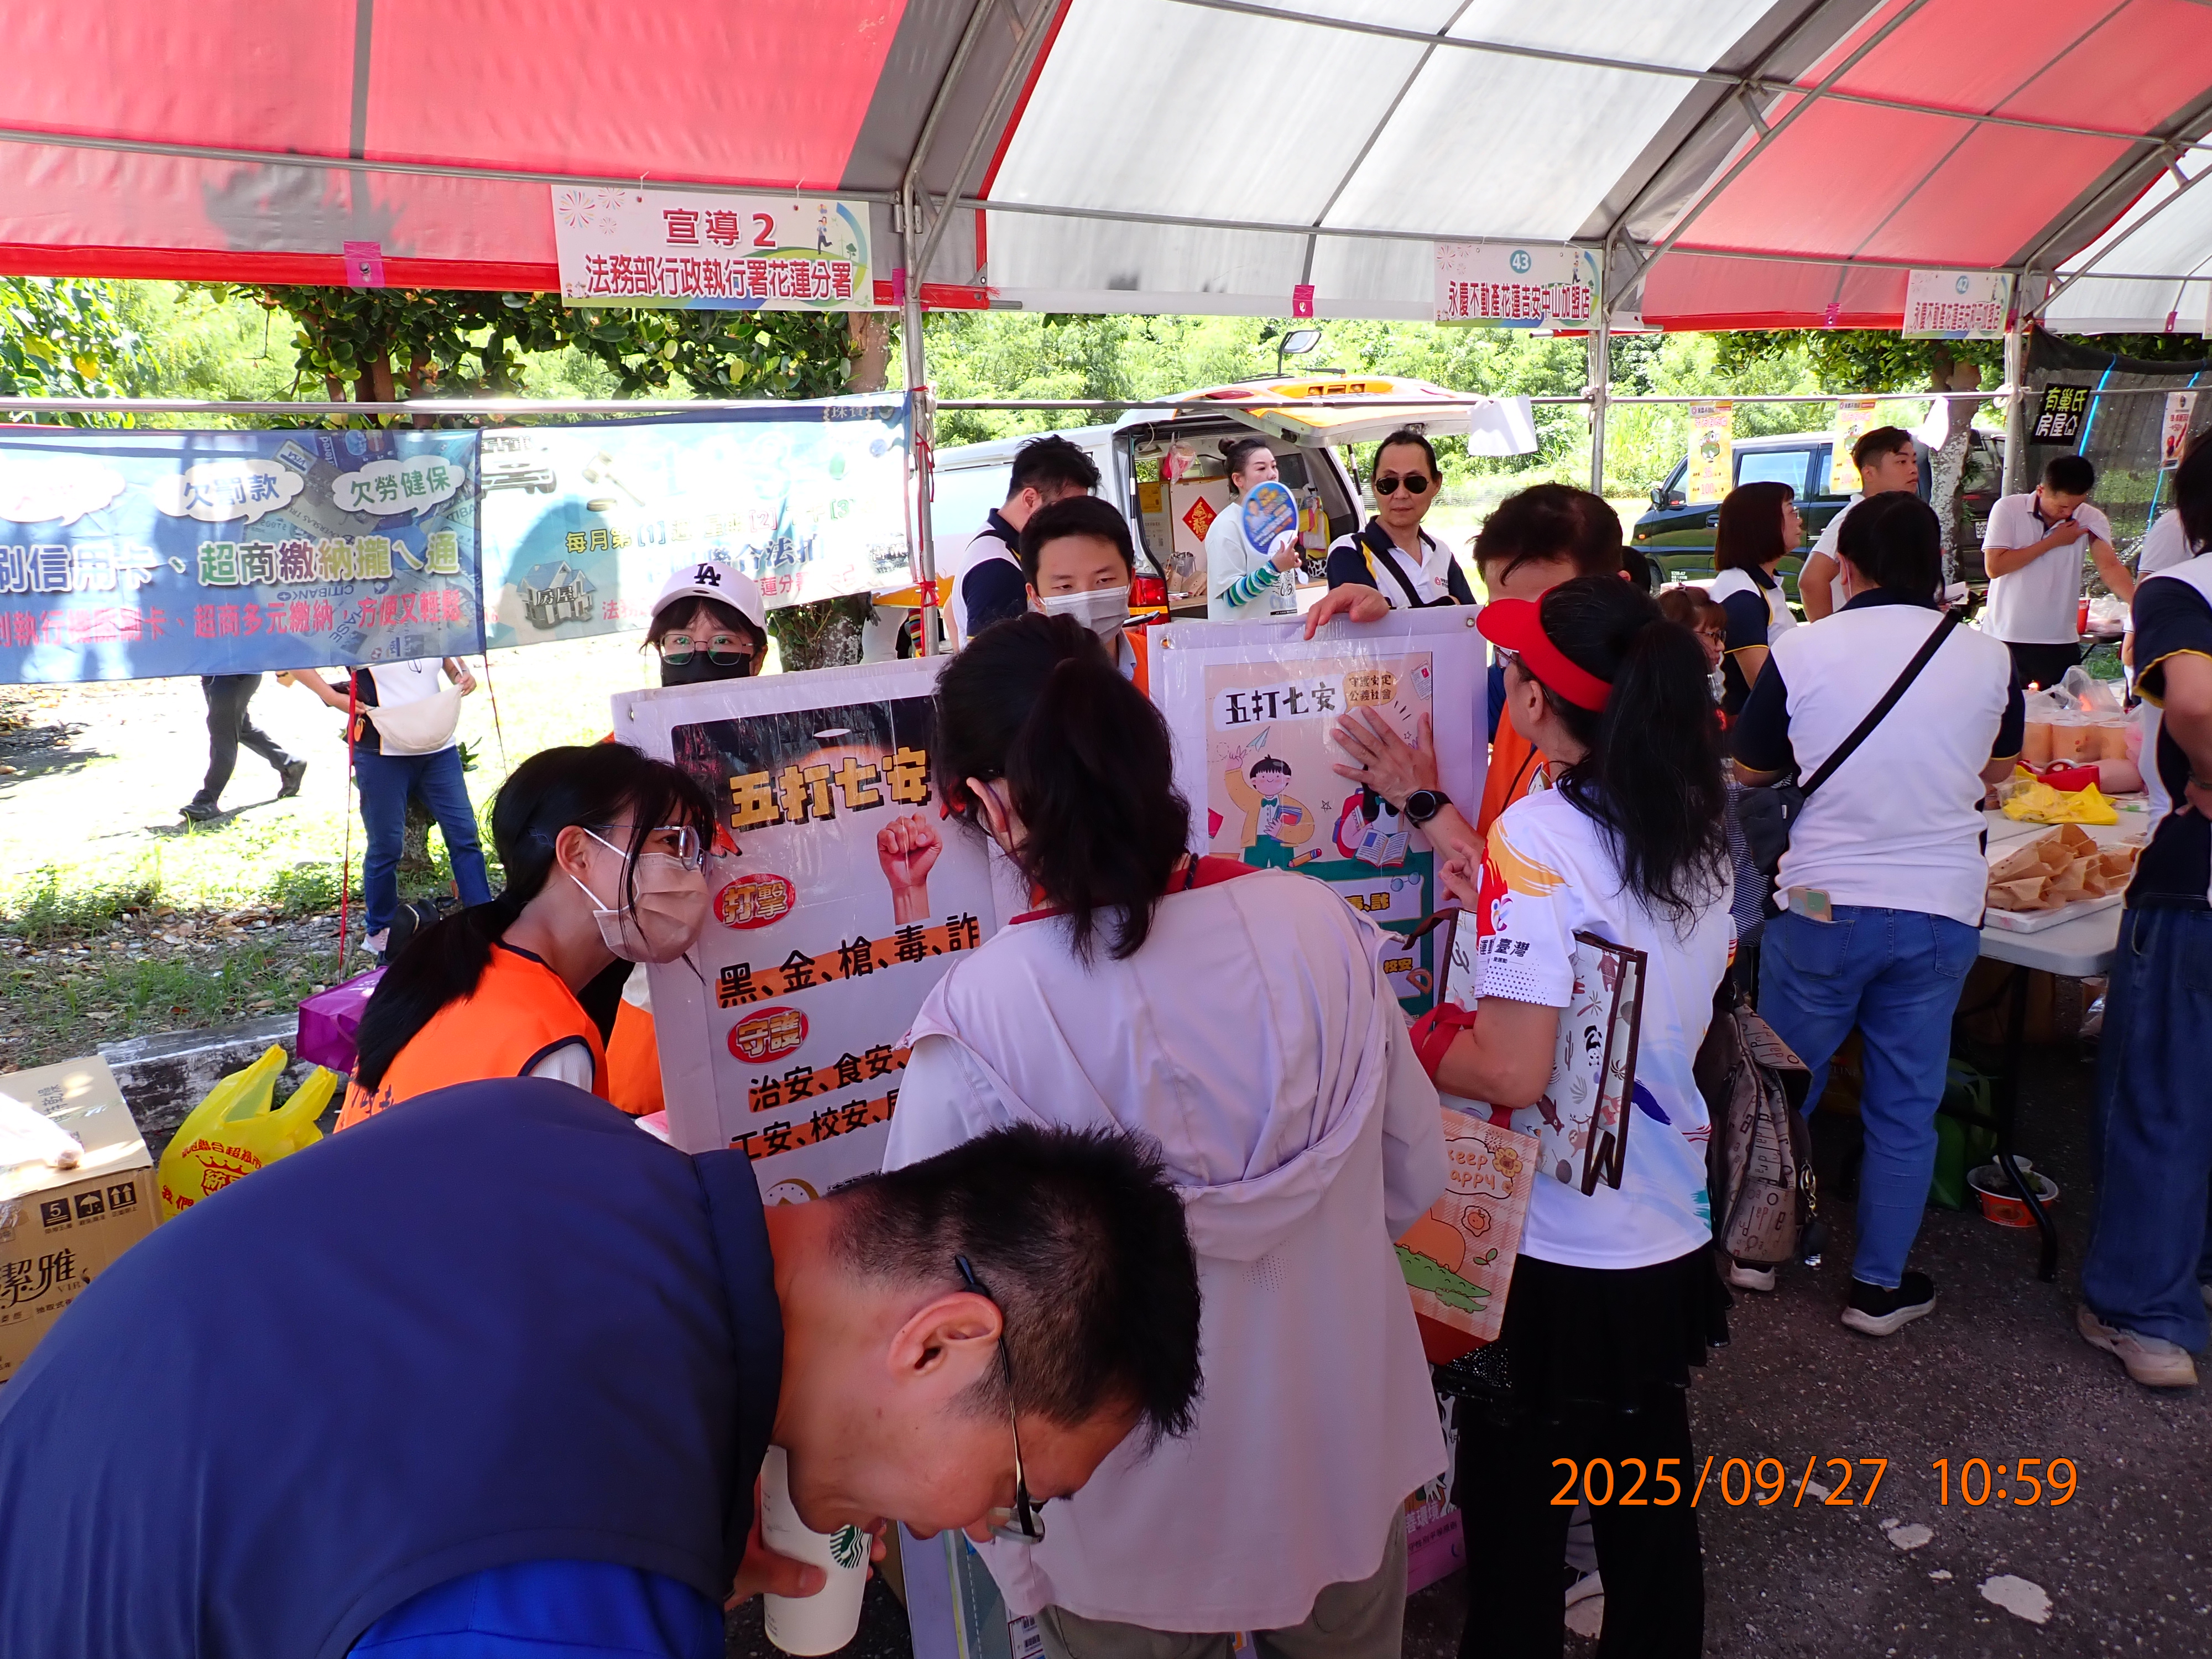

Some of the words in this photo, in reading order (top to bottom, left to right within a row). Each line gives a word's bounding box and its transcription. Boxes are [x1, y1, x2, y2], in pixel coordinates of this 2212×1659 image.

[662, 208, 740, 247] 宣導
[753, 213, 778, 247] 2
[585, 254, 852, 300] 法務部行政執行署花蓮分署
[1512, 253, 1529, 270] 43
[1448, 280, 1591, 320] 永慶不動產花蓮吉安中山加盟店
[1957, 279, 1968, 291] 42
[2045, 387, 2088, 412] 有巢氏
[2035, 414, 2068, 437] 房屋
[184, 473, 280, 510] 欠罰款
[350, 465, 451, 507] 欠勞健保
[693, 562, 721, 587] LA
[536, 586, 575, 607] 房屋
[1349, 674, 1391, 687] 守護安定
[1349, 688, 1391, 702] 公義社會
[1225, 682, 1337, 726] 五打七安
[730, 747, 932, 832] 五打七安
[722, 881, 785, 926] 打擊
[719, 911, 980, 1008] 黑、金、槍、毒、詐
[1383, 957, 1413, 974] 校安
[737, 1012, 806, 1056] 守護
[750, 1043, 914, 1113] 治安、食安、
[50, 1202, 61, 1217] 5
